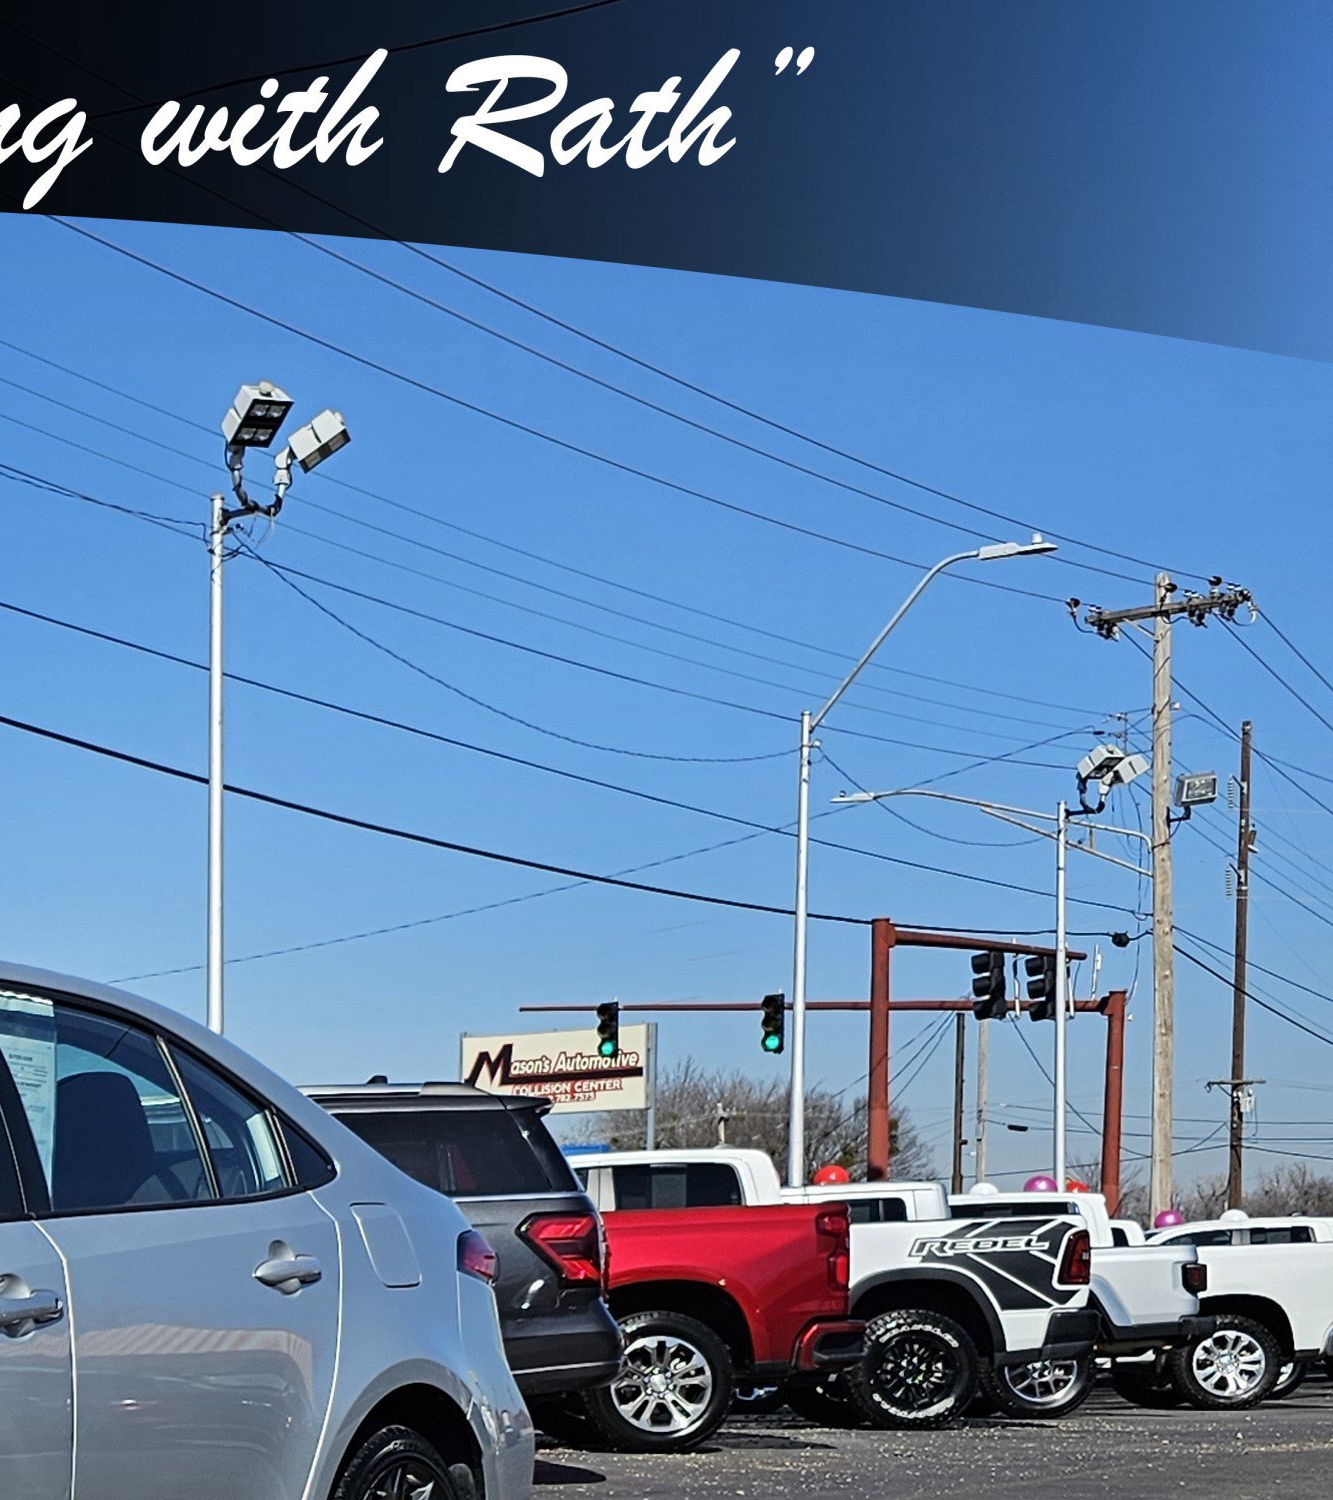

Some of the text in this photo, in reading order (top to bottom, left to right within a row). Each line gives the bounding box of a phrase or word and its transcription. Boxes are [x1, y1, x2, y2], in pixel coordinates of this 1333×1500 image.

[464, 1043, 551, 1087] Mason's
[513, 1079, 622, 1096] COLLISION CENTER
[908, 1235, 1051, 1258] REBEL
